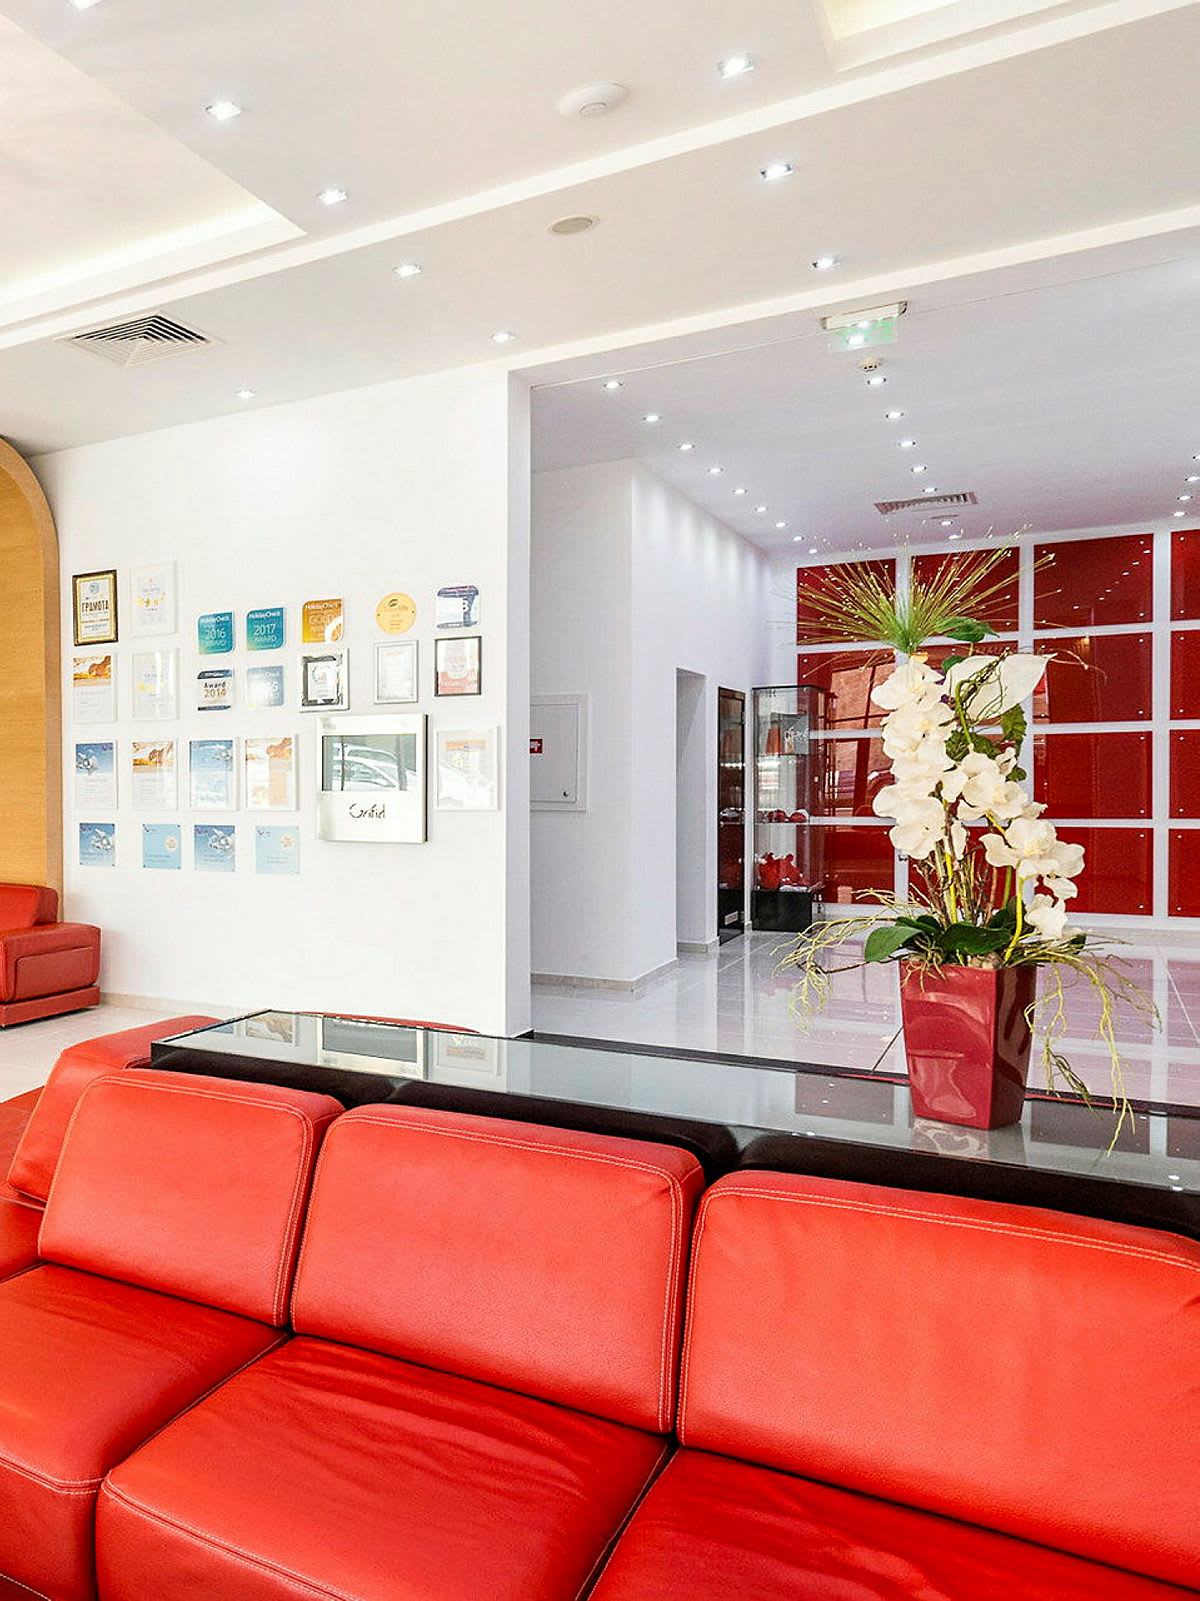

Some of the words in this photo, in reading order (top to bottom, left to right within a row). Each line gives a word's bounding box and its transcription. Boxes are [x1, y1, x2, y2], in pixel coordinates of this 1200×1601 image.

[254, 624, 277, 635] 2017
[203, 681, 226, 689] Award
[349, 803, 385, 819] Grifid
